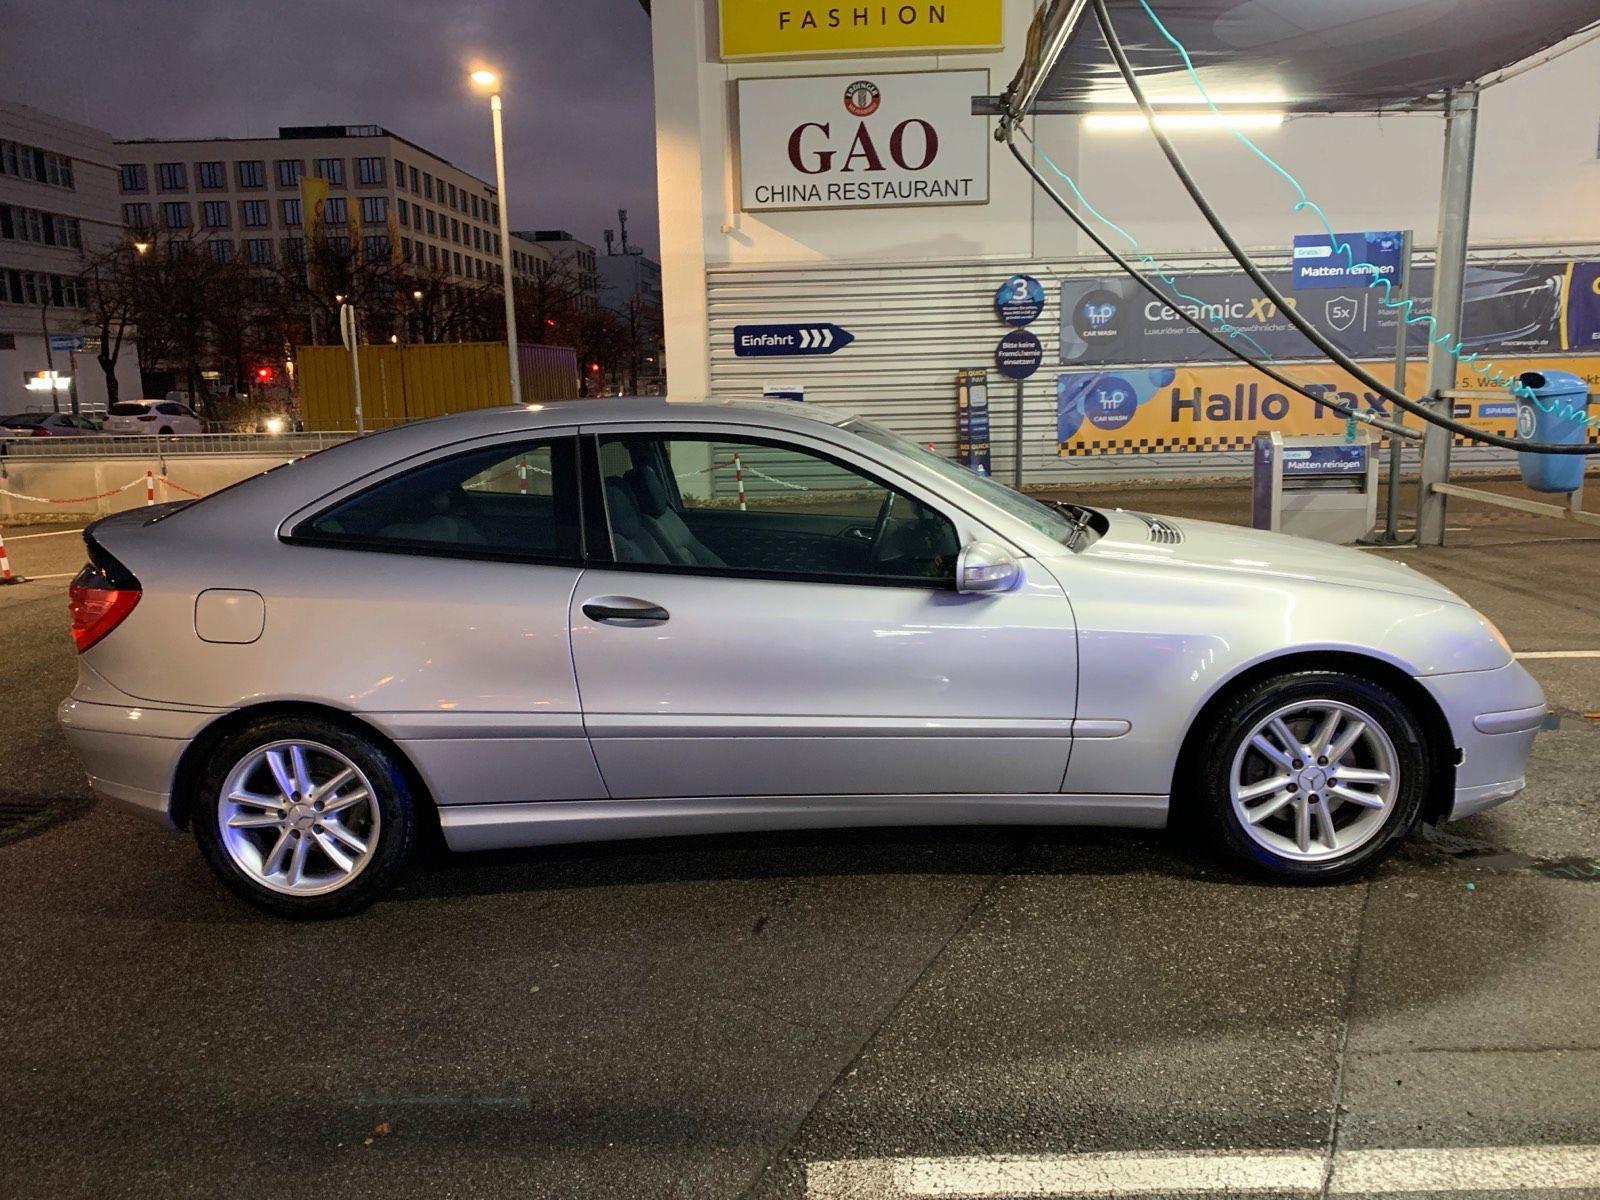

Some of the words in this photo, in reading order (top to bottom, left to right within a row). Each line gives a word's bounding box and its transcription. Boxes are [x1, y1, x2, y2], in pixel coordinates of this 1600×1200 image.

[778, 5, 946, 31] FASHION
[787, 118, 939, 175] GAO
[755, 183, 822, 203] CHINA
[827, 178, 973, 201] RESTAURANT
[1300, 266, 1344, 277] Matten
[1012, 278, 1028, 300] 3
[1332, 306, 1350, 319] 5x
[741, 334, 794, 347] Einfahrt
[1170, 383, 1290, 422] Hallo
[1303, 382, 1391, 420] Tax
[1287, 461, 1321, 470] Matten
[1322, 459, 1361, 470] reinigen
